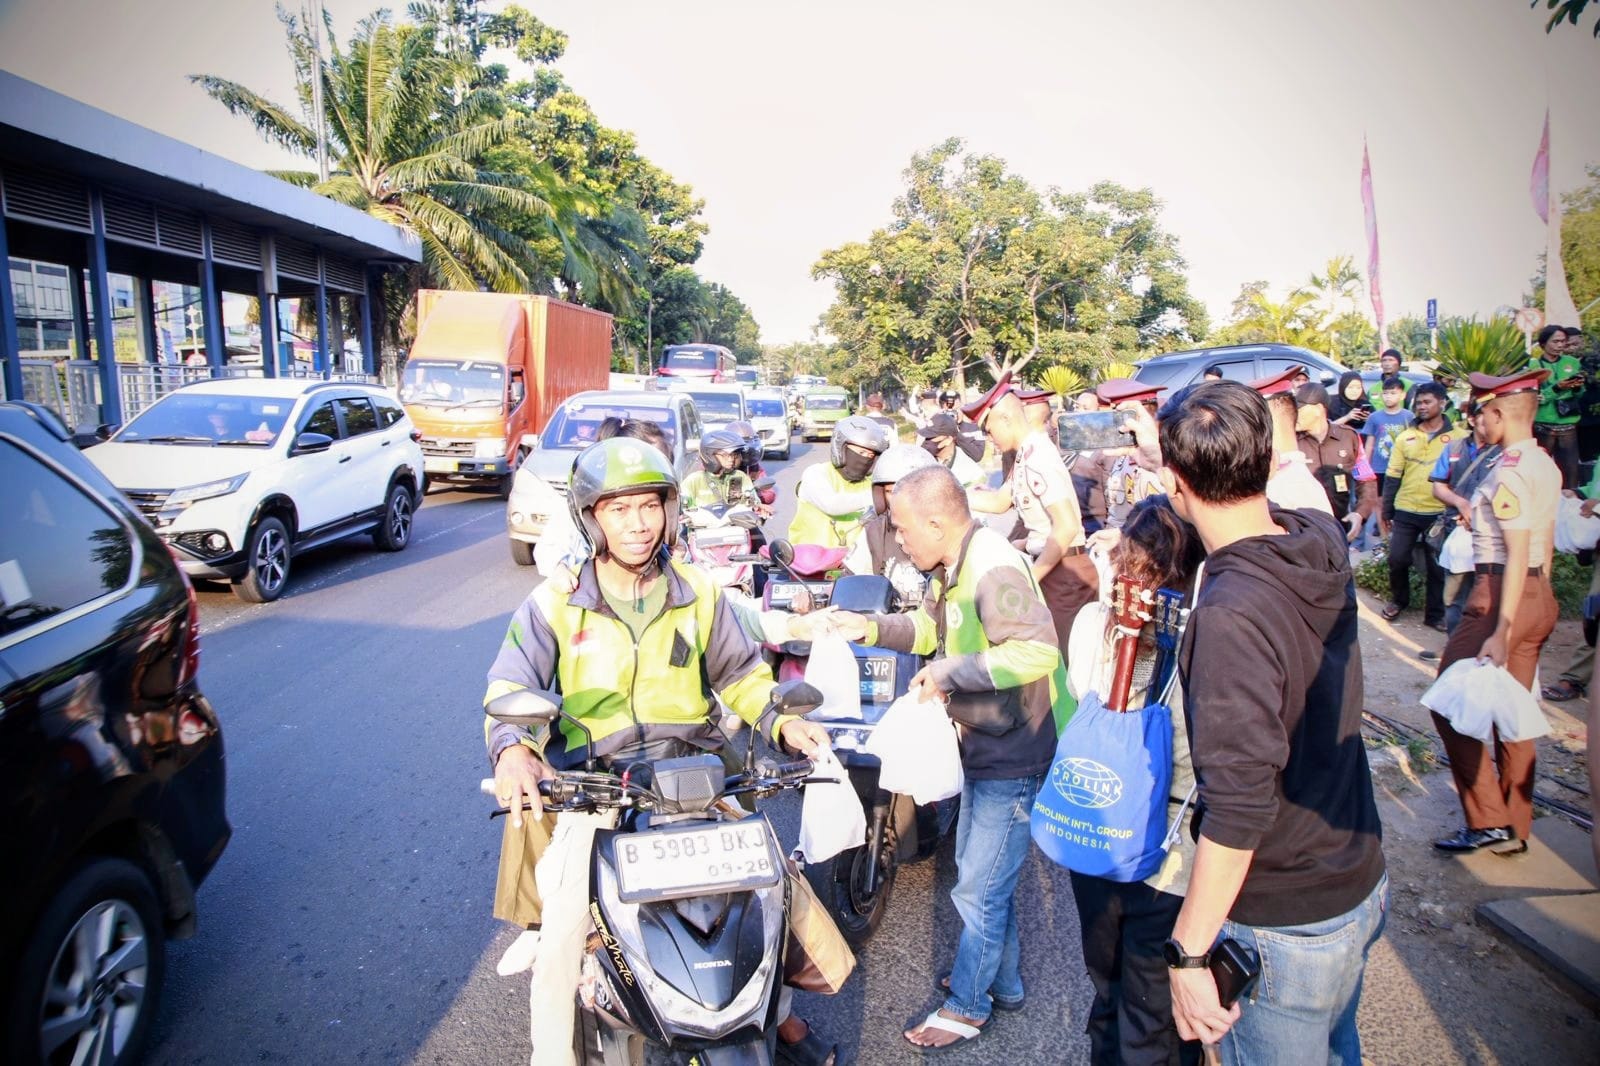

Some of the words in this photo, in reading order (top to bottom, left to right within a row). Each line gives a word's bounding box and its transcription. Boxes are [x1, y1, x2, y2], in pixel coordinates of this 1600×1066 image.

[864, 661, 889, 676] SVR
[1034, 802, 1070, 827] PROLINK
[1071, 818, 1095, 834] INT'L
[1097, 825, 1133, 840] GROUP
[625, 843, 639, 864] B
[652, 835, 710, 860] 5983
[720, 828, 765, 852] BKJ
[1045, 822, 1111, 850] INDONESIA
[694, 960, 732, 969] HONDA
